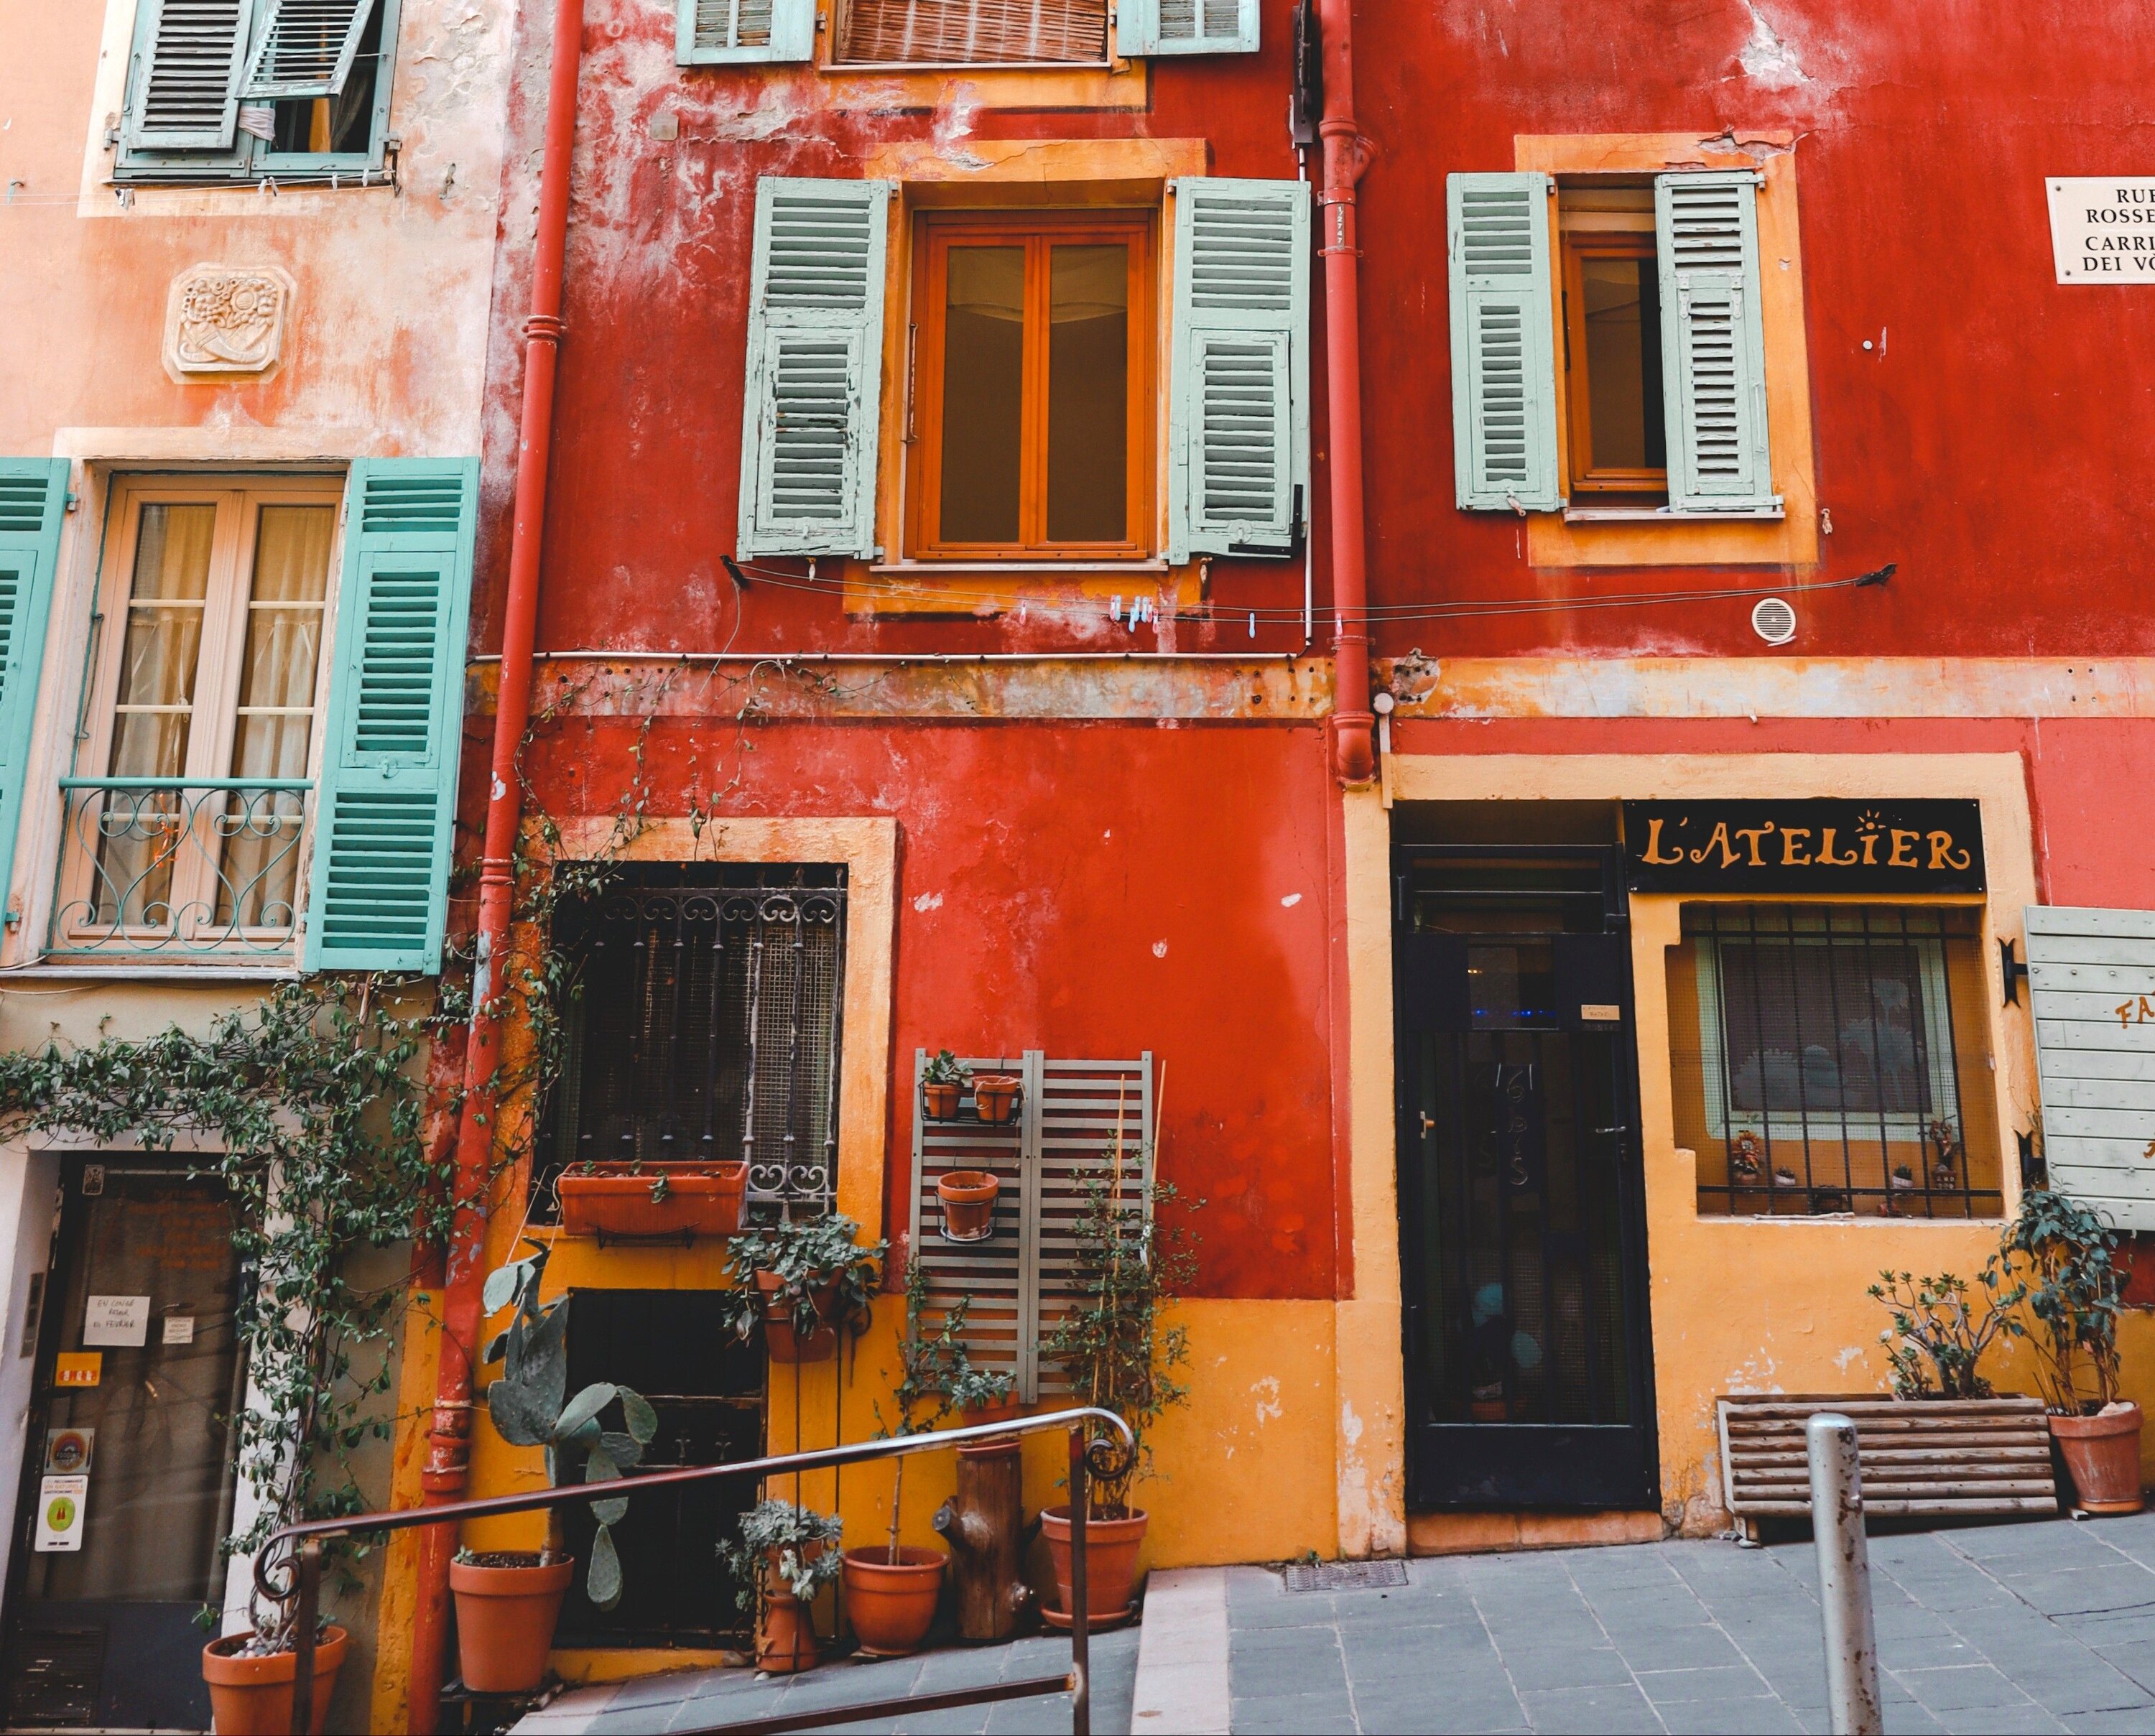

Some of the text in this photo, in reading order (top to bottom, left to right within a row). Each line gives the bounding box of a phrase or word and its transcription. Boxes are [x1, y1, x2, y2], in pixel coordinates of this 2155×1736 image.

[2086, 208, 2155, 223] ROSSE
[2085, 236, 2155, 251] CARRI
[2082, 256, 2122, 271] DEI
[2115, 991, 2155, 1029] FA
